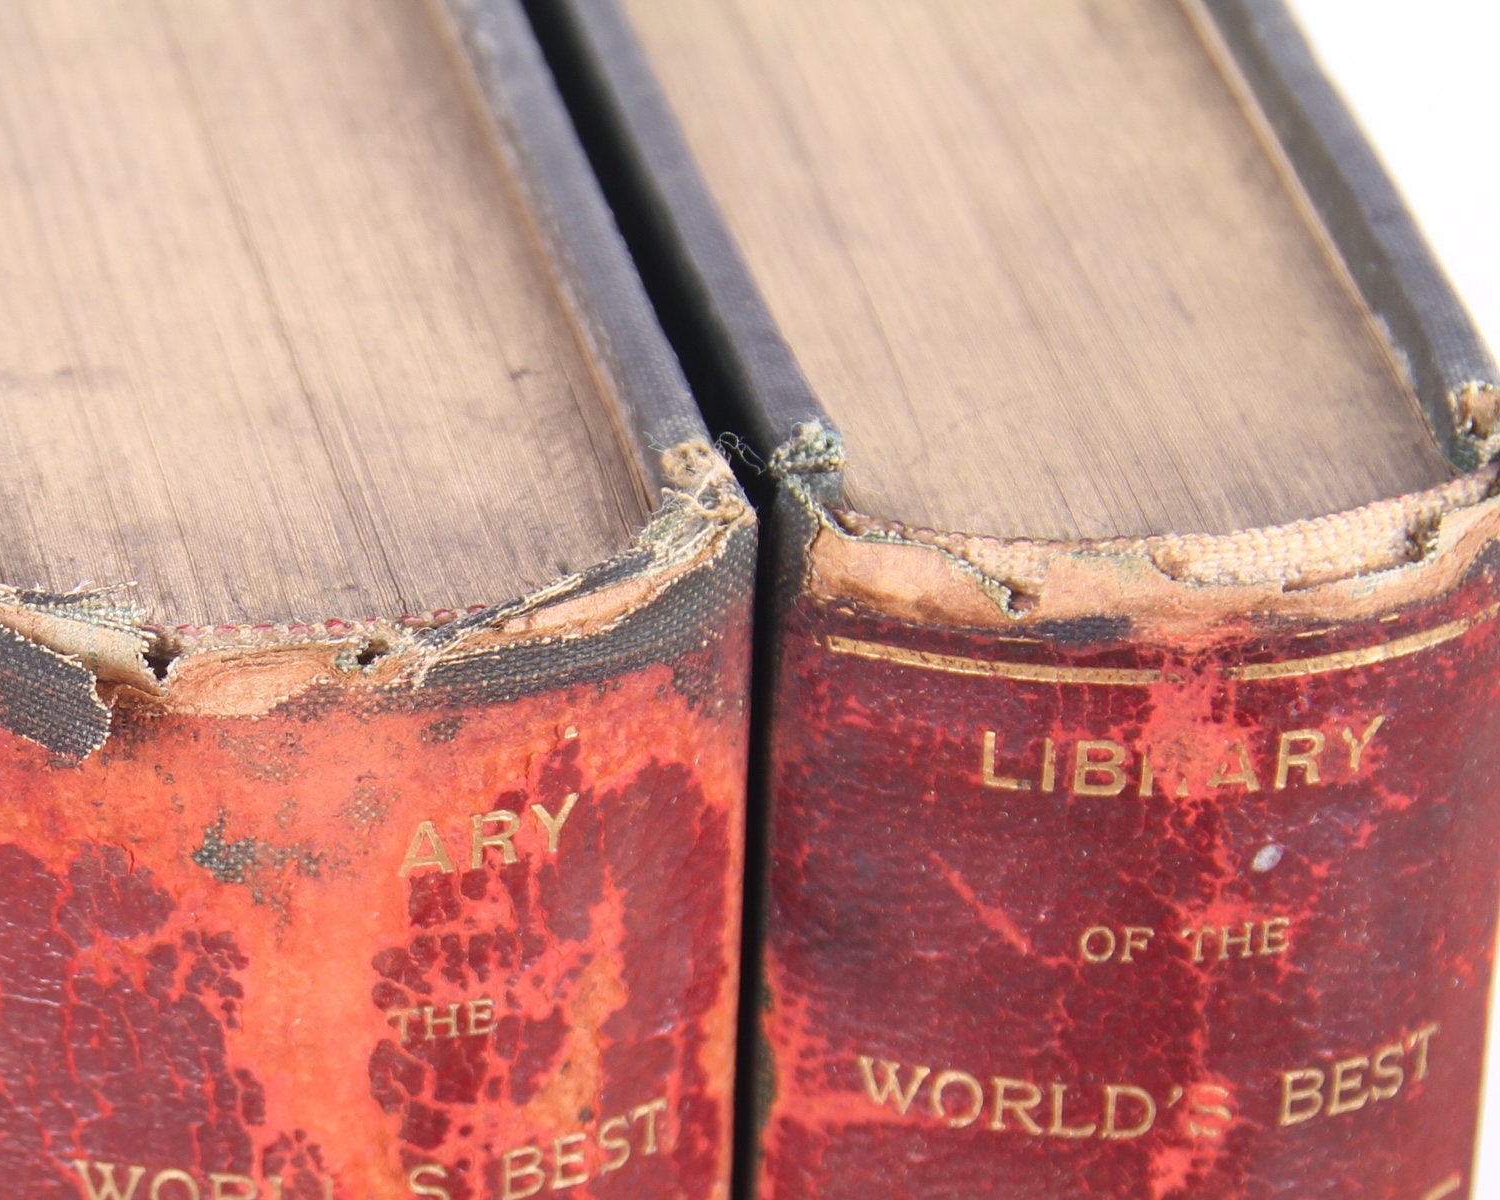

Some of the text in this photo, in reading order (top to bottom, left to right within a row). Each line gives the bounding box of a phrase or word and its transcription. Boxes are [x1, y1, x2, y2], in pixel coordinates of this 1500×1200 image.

[1080, 917, 1291, 964] OF THE
[389, 999, 497, 1043] THE
[858, 1022, 1442, 1141] WORLD'S BEST
